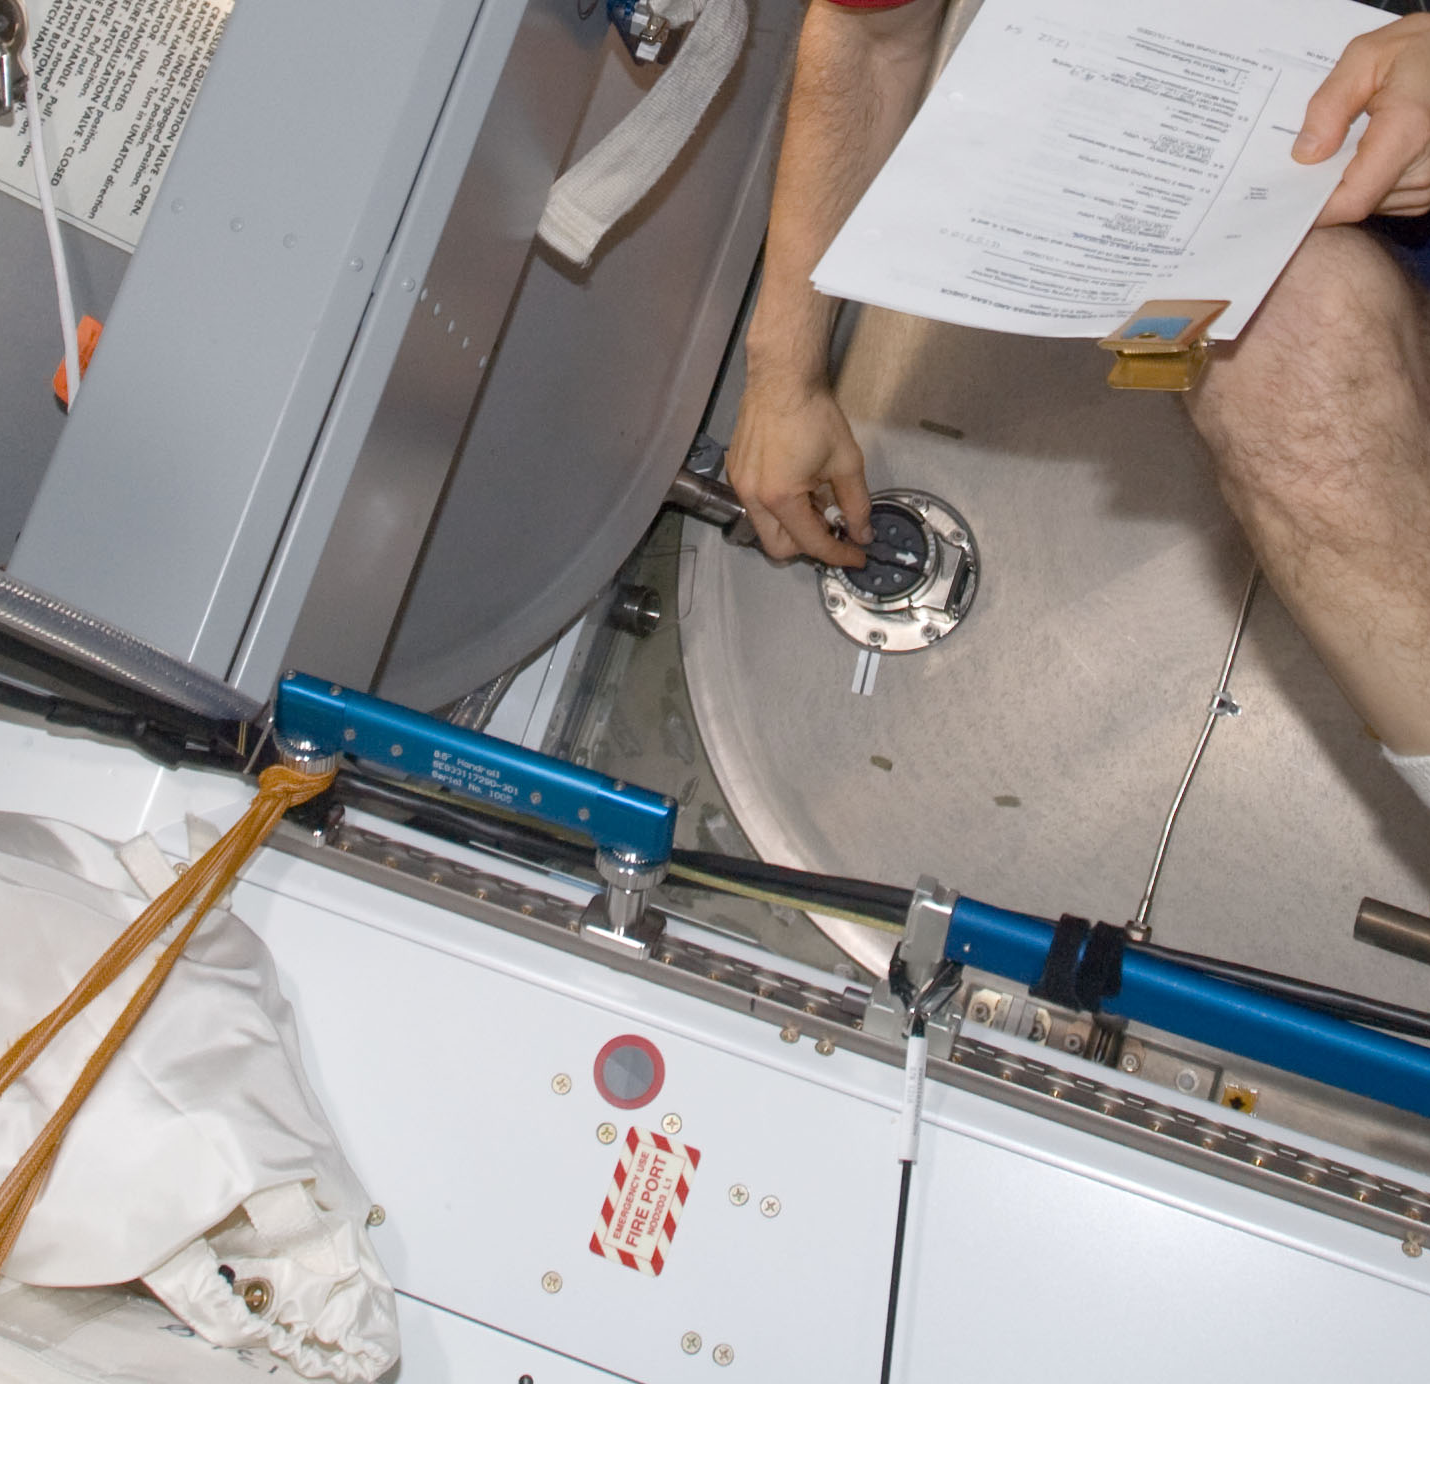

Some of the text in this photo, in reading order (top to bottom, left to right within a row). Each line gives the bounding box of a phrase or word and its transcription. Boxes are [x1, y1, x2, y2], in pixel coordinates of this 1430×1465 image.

[65, 3, 87, 38] travel
[76, 6, 100, 43] LATCH
[98, 18, 121, 53] LATCH
[123, 16, 150, 60] HANDLE
[155, 13, 179, 49] travel.
[32, 31, 61, 77] BUTTON
[58, 37, 71, 51] to
[84, 34, 101, 56] Pull
[155, 33, 182, 77] HANDLE
[39, 50, 65, 92] stowed
[55, 42, 83, 88] HANDLE
[73, 55, 90, 79] out.
[75, 52, 105, 100] position.
[89, 23, 133, 103] EQUALIZATION
[110, 48, 149, 115] UNLATCHED.
[133, 0, 211, 149] RATCHET UNLATCH position.
[41, 95, 58, 117] Pull
[99, 67, 126, 109] Stowed
[127, 4, 221, 189] CRANK HANDLE Engaged position.
[139, 84, 157, 109] Turn
[164, 62, 208, 141] EQUALIZATION
[72, 103, 95, 138] VALVE
[76, 108, 106, 156] position.
[134, 109, 146, 122] in
[109, 122, 140, 174] UNLATCH
[149, 141, 171, 176] VALVE
[86, 173, 115, 221] direction
[128, 183, 151, 219] OPEN.
[940, 287, 967, 298] CHECK
[969, 294, 992, 304] LEAK
[993, 301, 1010, 310] AND
[431, 769, 463, 787] Serial
[467, 783, 483, 794] No.
[456, 757, 500, 778] Handrail
[612, 1151, 649, 1239] EMERGENCY USE
[625, 1153, 668, 1247] FIRE PORT
